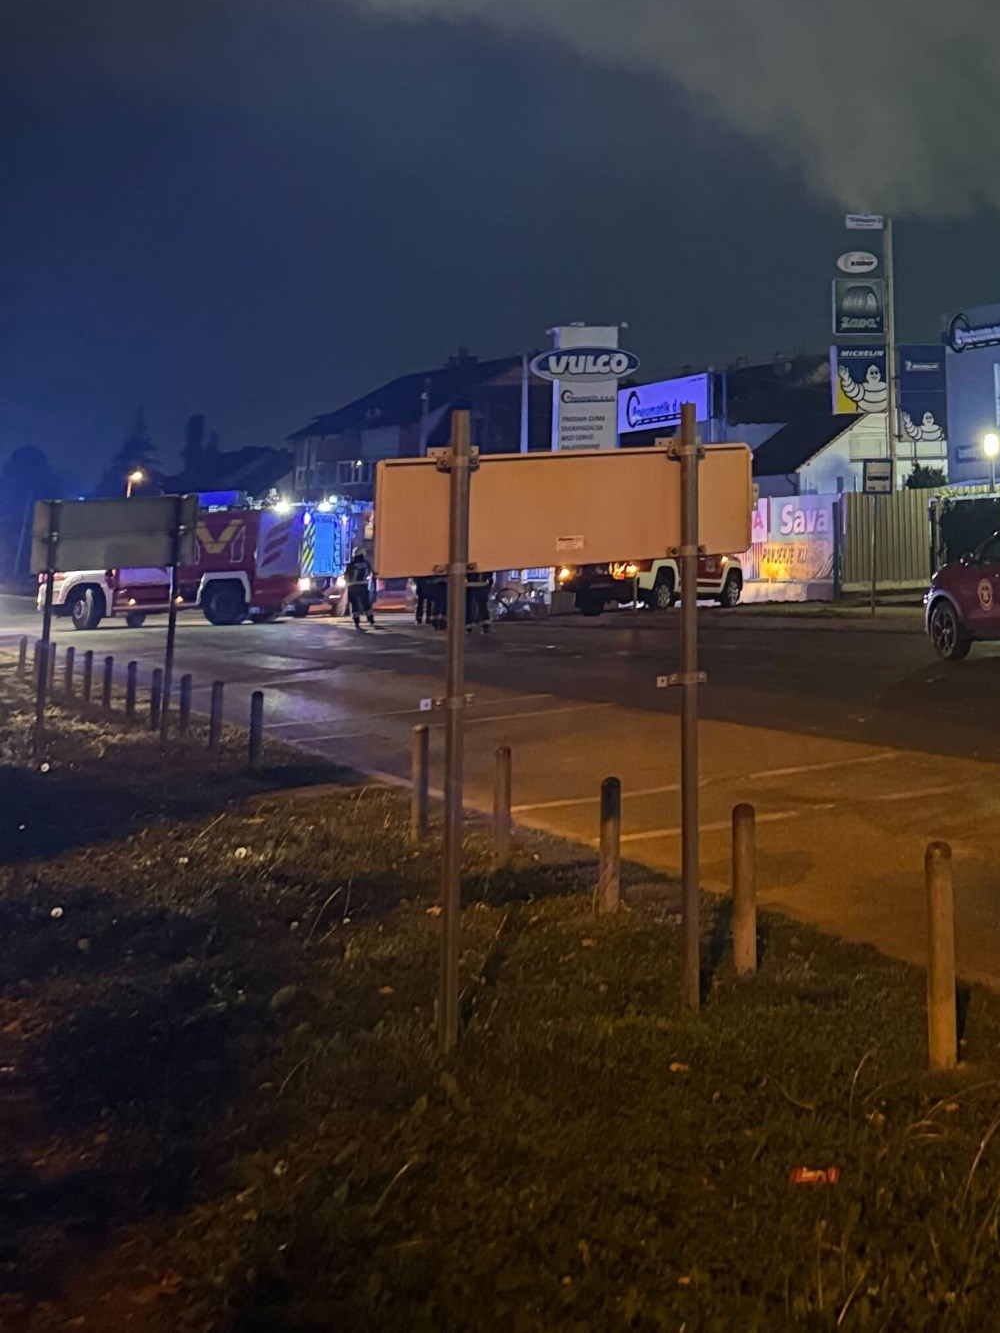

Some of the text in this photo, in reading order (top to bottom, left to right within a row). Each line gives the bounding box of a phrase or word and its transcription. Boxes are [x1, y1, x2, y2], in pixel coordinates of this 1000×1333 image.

[548, 353, 629, 375] VULCO
[840, 350, 884, 358] MICHELIN
[780, 503, 830, 536] Sava
